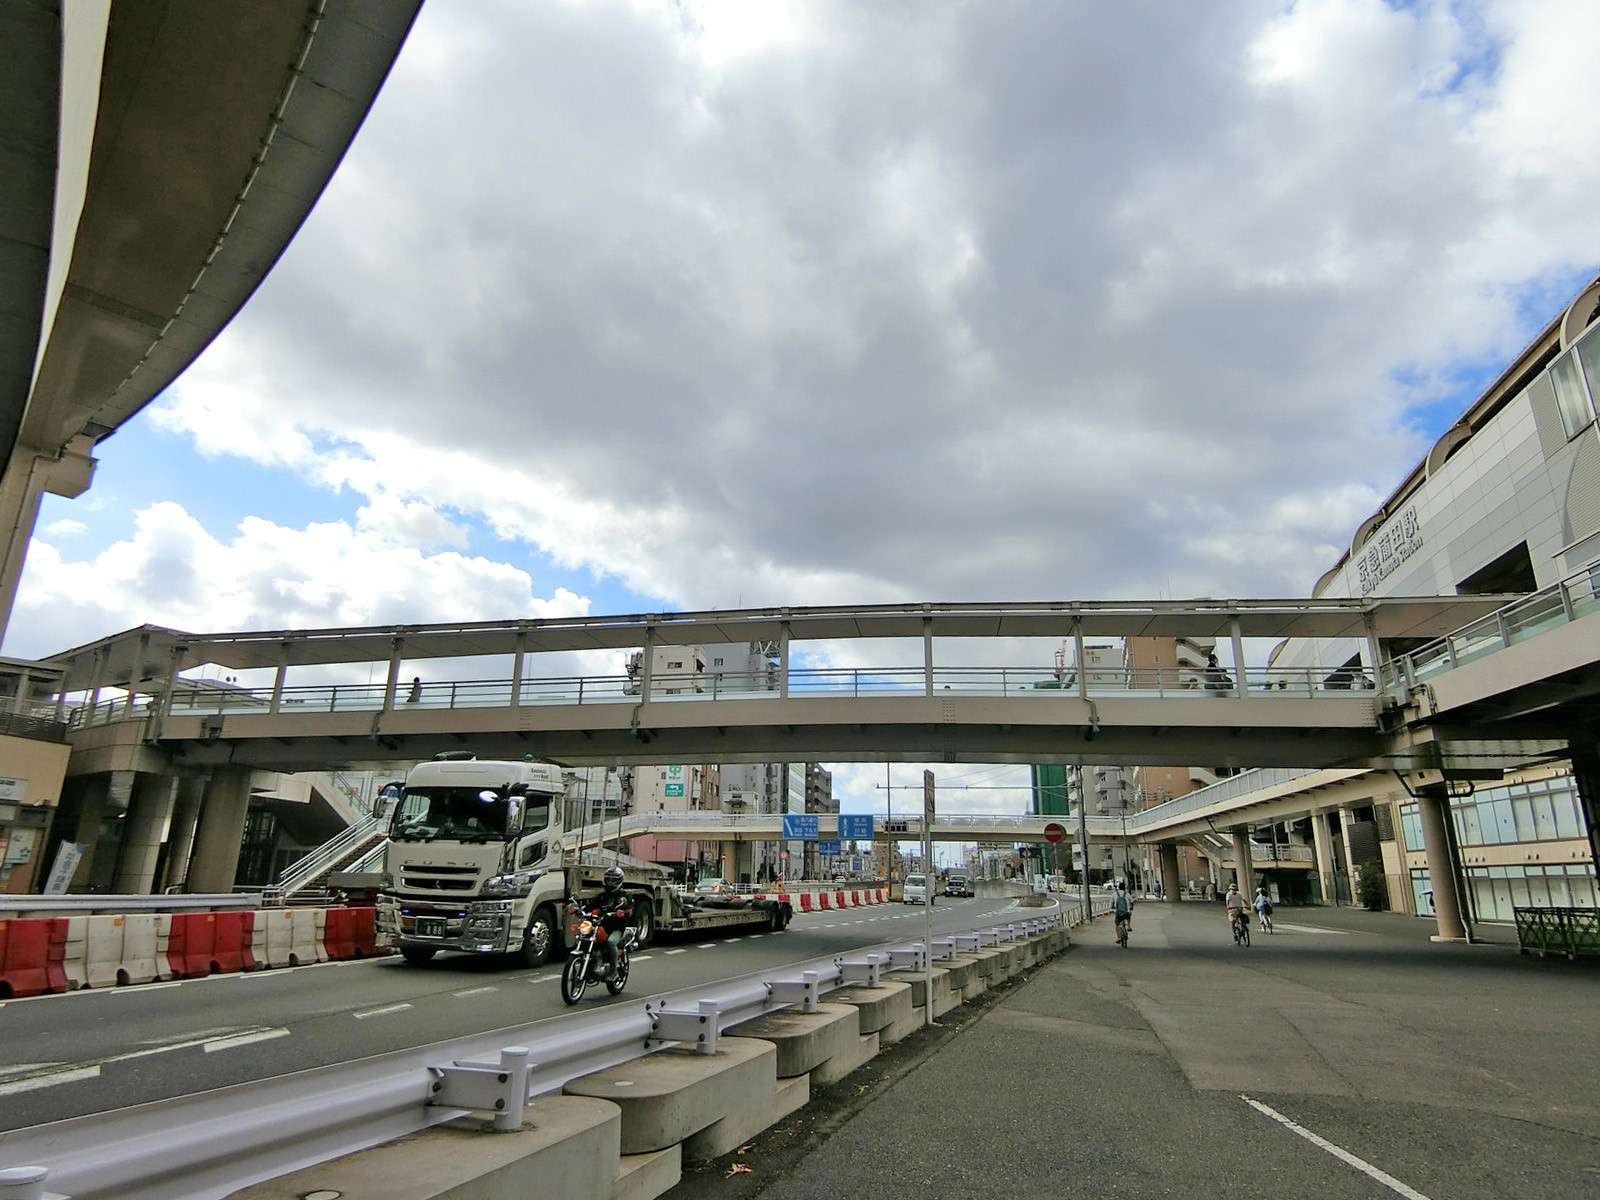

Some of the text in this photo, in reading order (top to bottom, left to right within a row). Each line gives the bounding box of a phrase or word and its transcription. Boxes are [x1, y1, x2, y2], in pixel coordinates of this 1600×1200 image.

[1357, 505, 1420, 582] 京急蒲田駅
